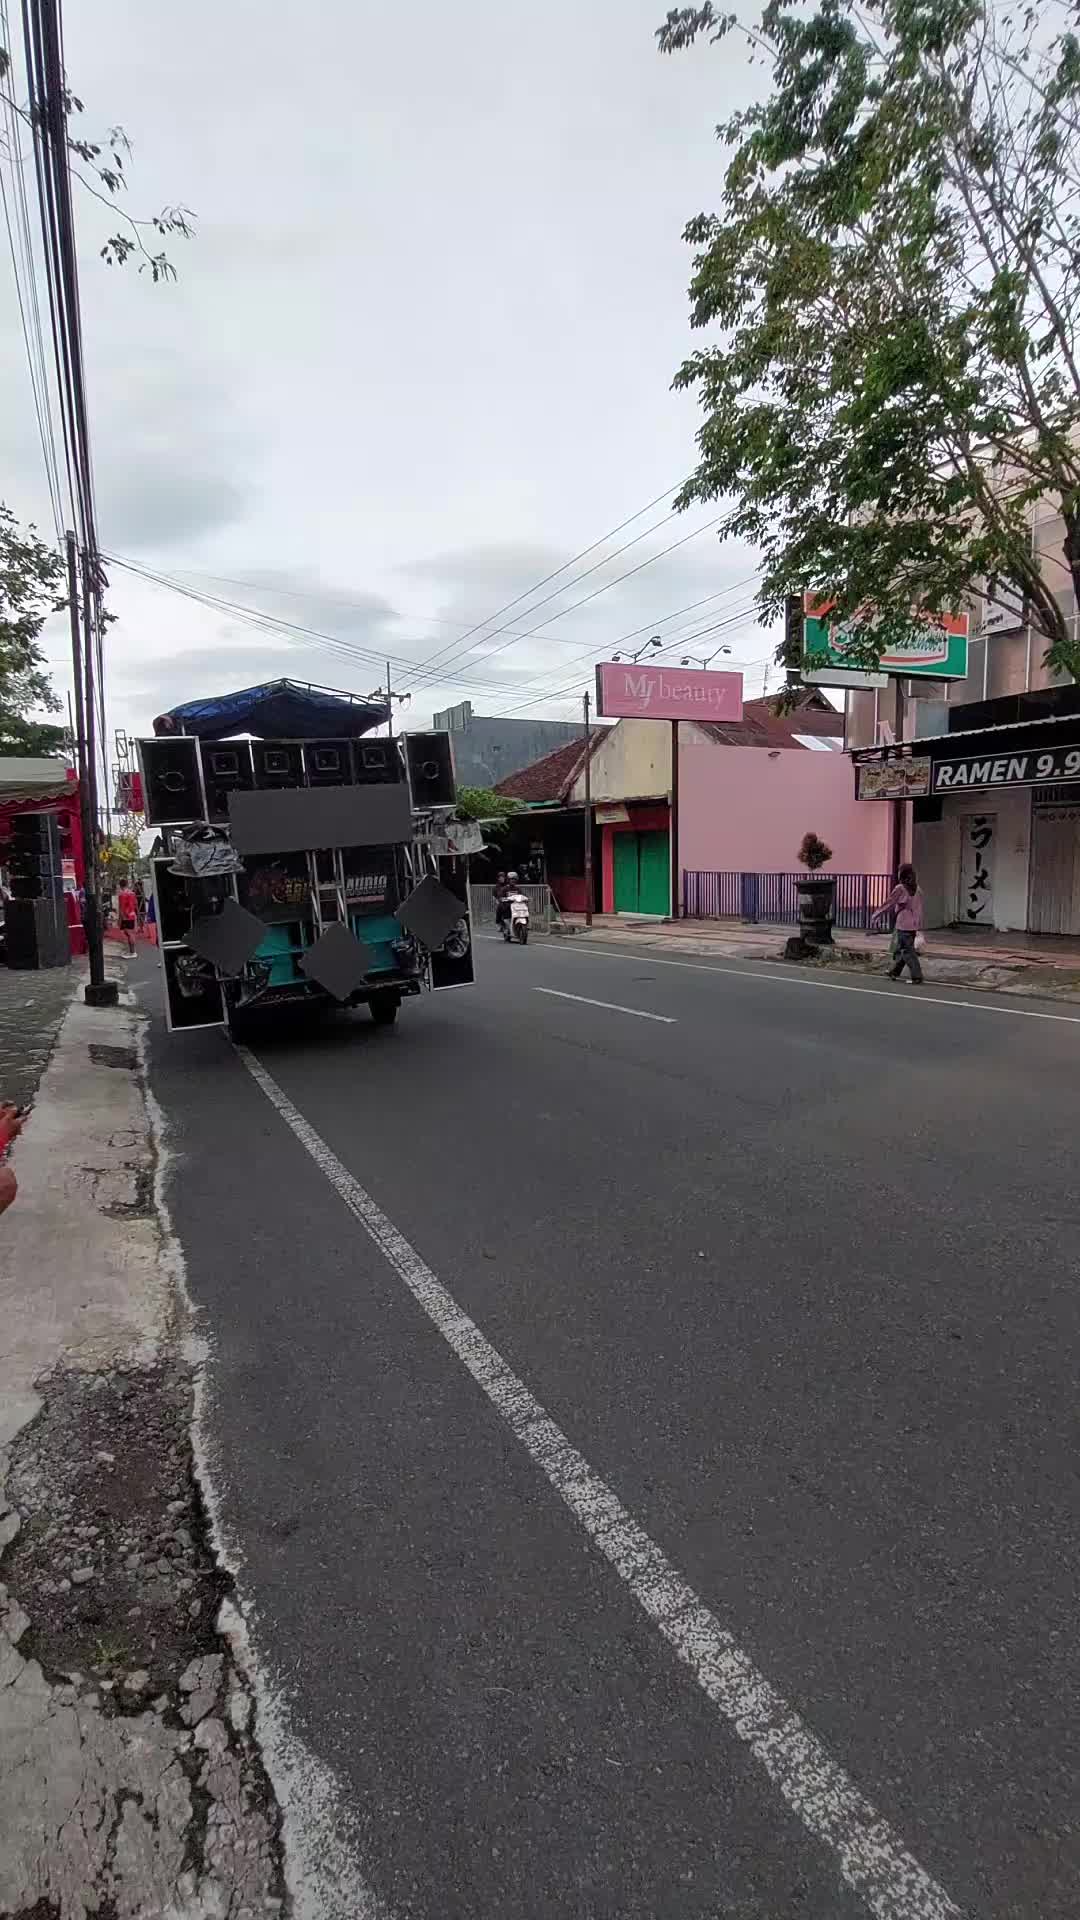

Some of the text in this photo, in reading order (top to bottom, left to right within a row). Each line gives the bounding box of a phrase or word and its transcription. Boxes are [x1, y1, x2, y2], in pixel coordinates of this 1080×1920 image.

[936, 757, 1029, 786] RAMEN
[967, 816, 993, 920] ラーメン
